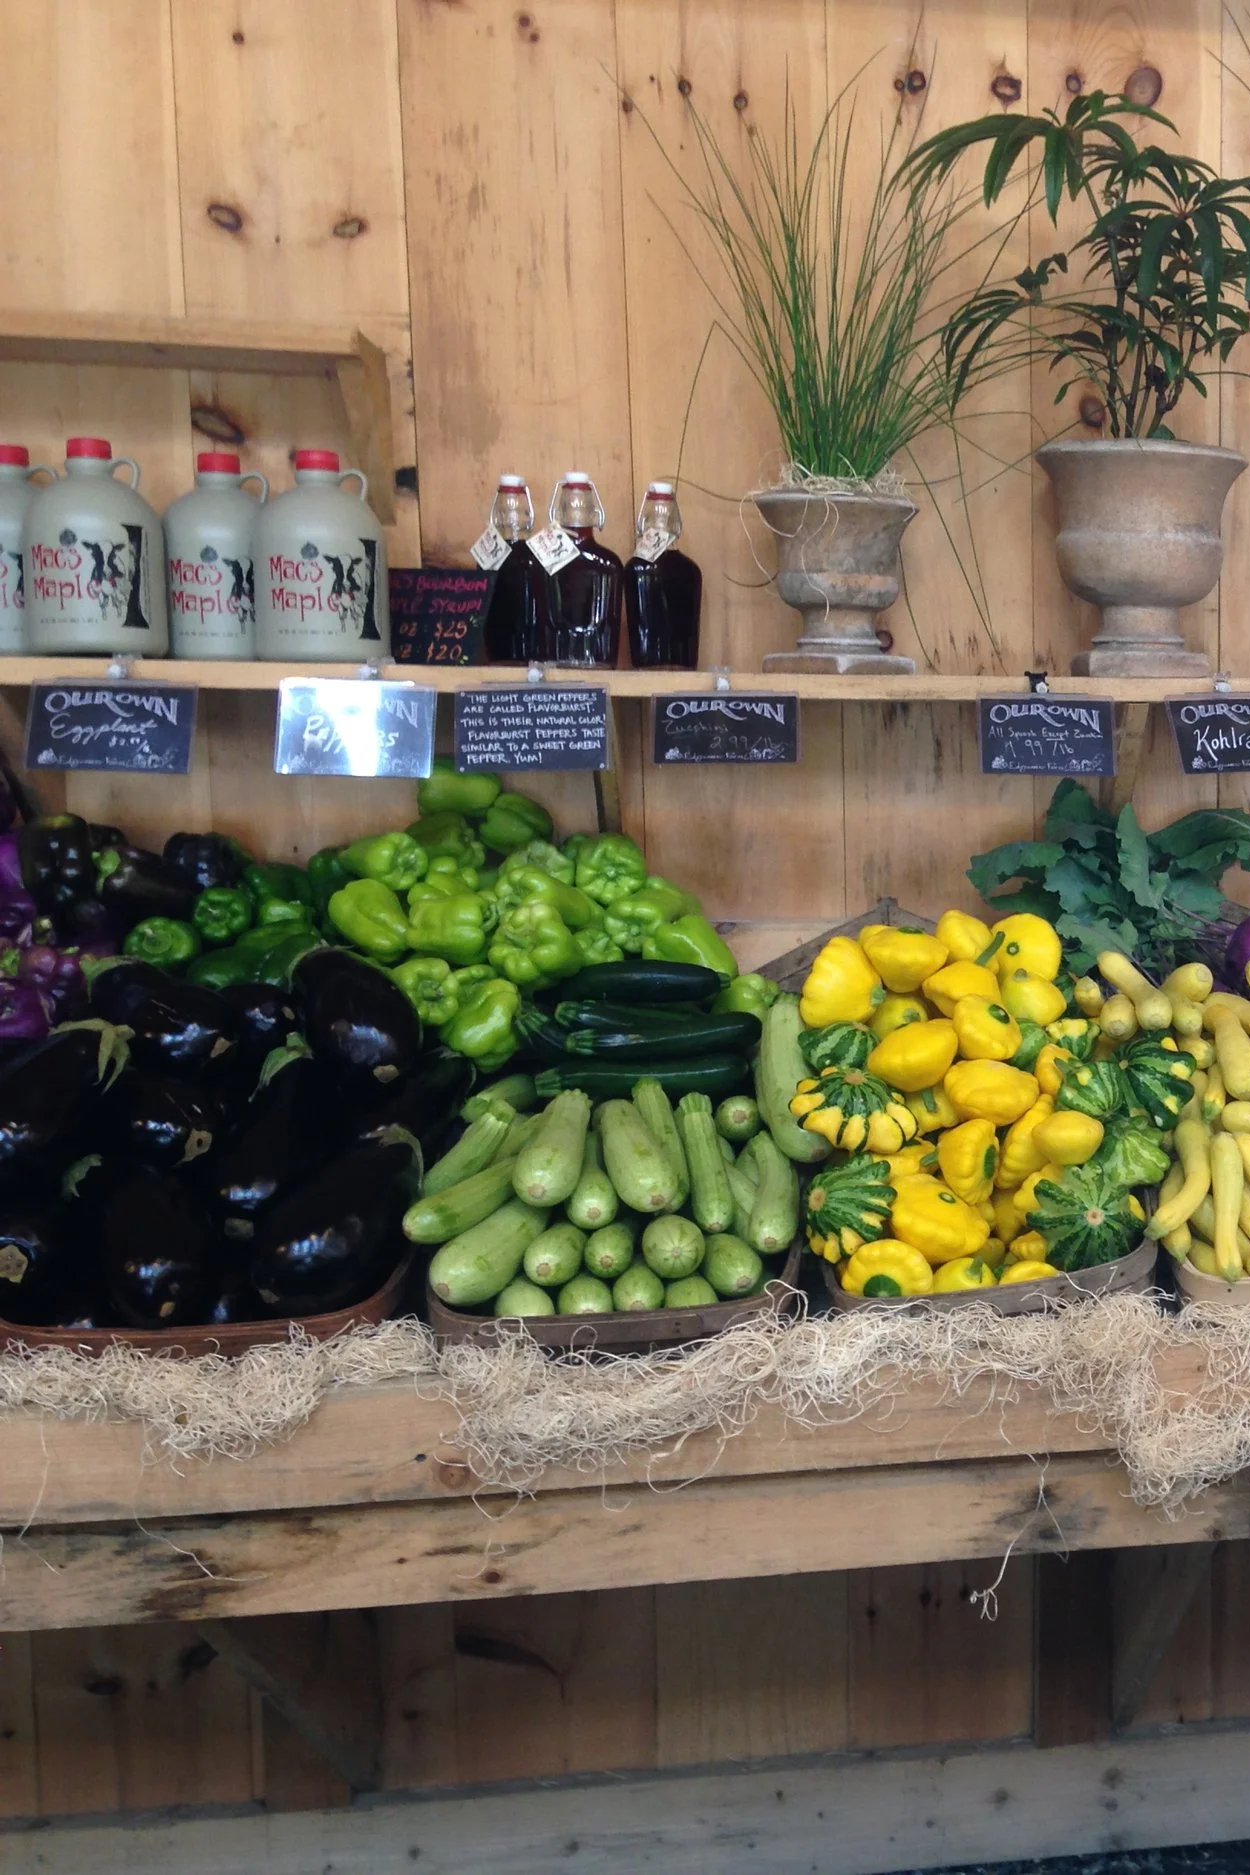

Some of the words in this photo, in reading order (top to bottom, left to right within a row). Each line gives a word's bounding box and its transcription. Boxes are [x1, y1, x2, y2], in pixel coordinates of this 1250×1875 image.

[34, 573, 101, 611] Maple
[172, 589, 240, 624] Maple
[271, 586, 339, 622] Maple
[467, 693, 487, 704] THE
[491, 693, 519, 703] LIGHT
[523, 694, 556, 702] GREEN
[557, 693, 597, 702] PEPPERS
[463, 705, 483, 714] ARE
[490, 704, 525, 714] CALLED
[528, 702, 595, 713] FLAVORBURST.
[461, 717, 484, 728] THIS
[488, 717, 498, 726] IS
[501, 717, 533, 727] THEIR
[536, 716, 577, 725] NATURAL
[578, 714, 606, 725] COLOR!
[50, 713, 158, 745] Eggplant
[468, 729, 530, 741] FLAVORBURST
[535, 728, 577, 739] PEPPERS
[581, 727, 606, 738] TASTE
[988, 726, 1004, 738] All
[461, 742, 503, 753] SIMILAR
[506, 742, 518, 752] TO
[521, 742, 530, 751] A
[533, 741, 566, 750] SWEET
[569, 741, 601, 749] GREEN
